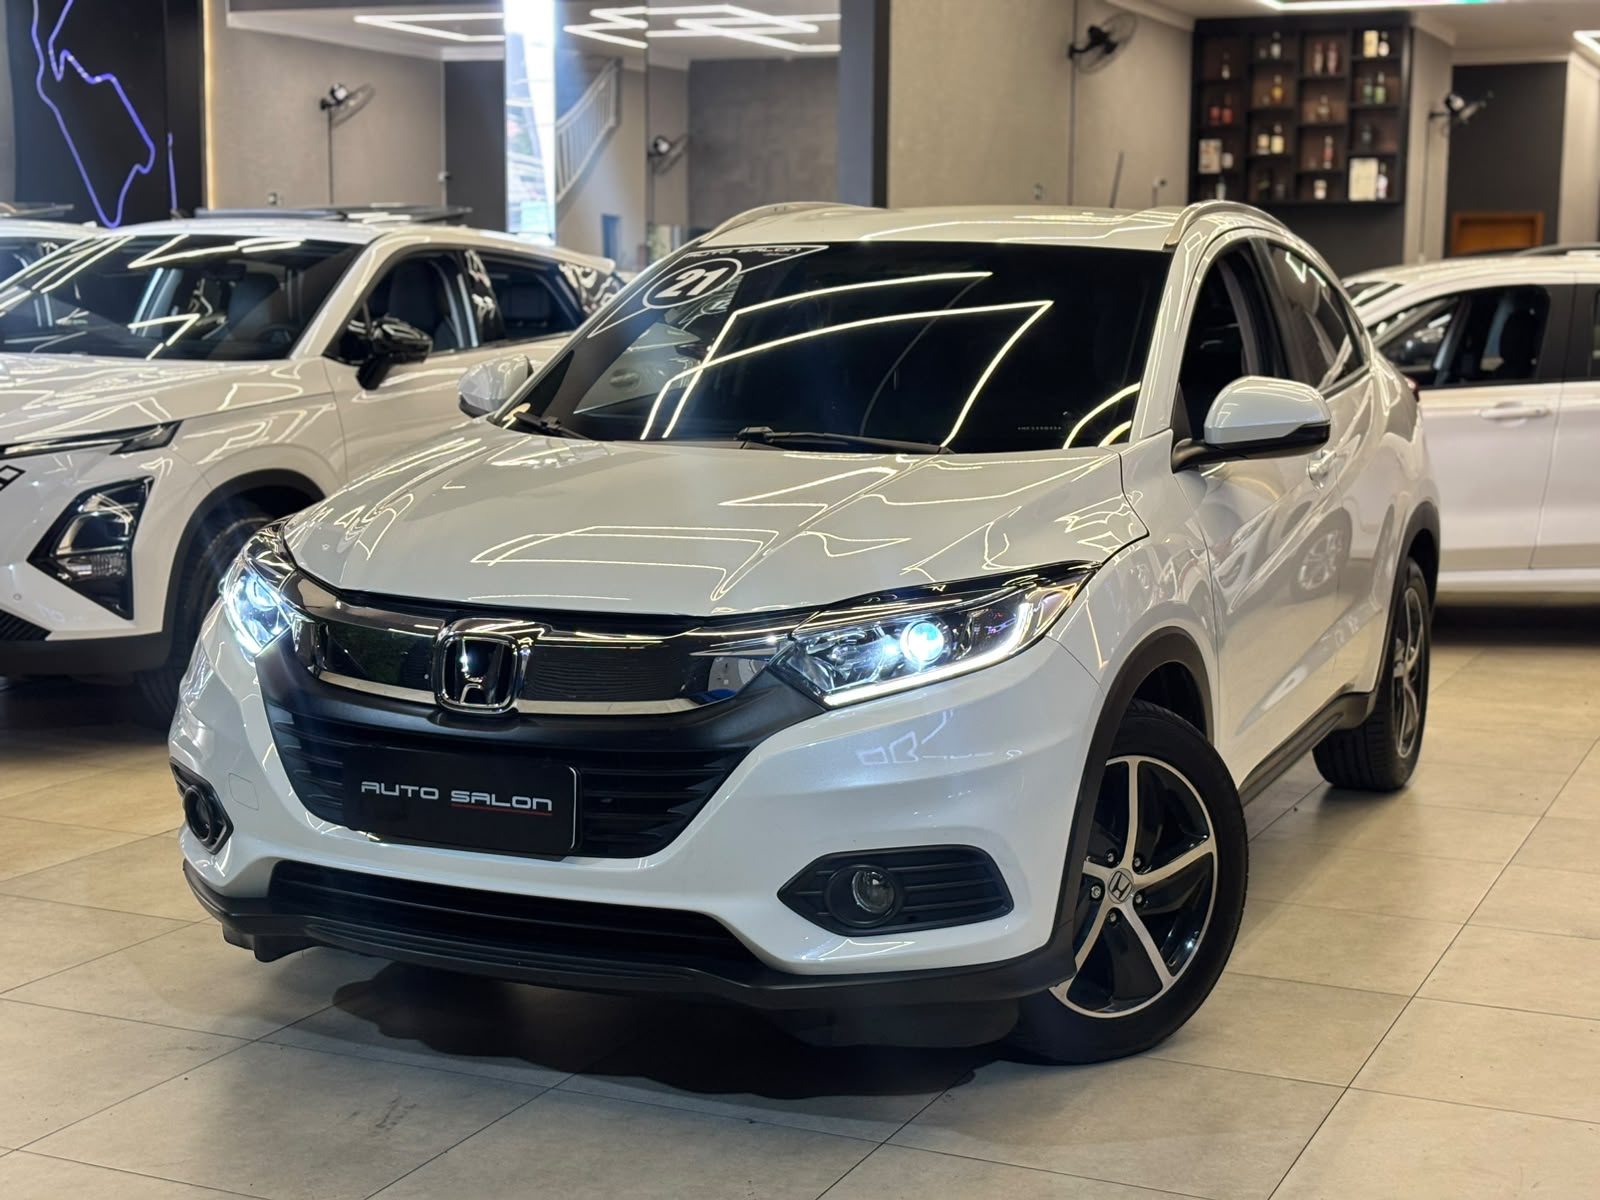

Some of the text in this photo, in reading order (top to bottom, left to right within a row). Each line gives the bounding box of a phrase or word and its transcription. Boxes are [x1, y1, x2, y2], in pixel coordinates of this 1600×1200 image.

[654, 267, 730, 298] 21
[361, 781, 552, 811] AUTO SALON
